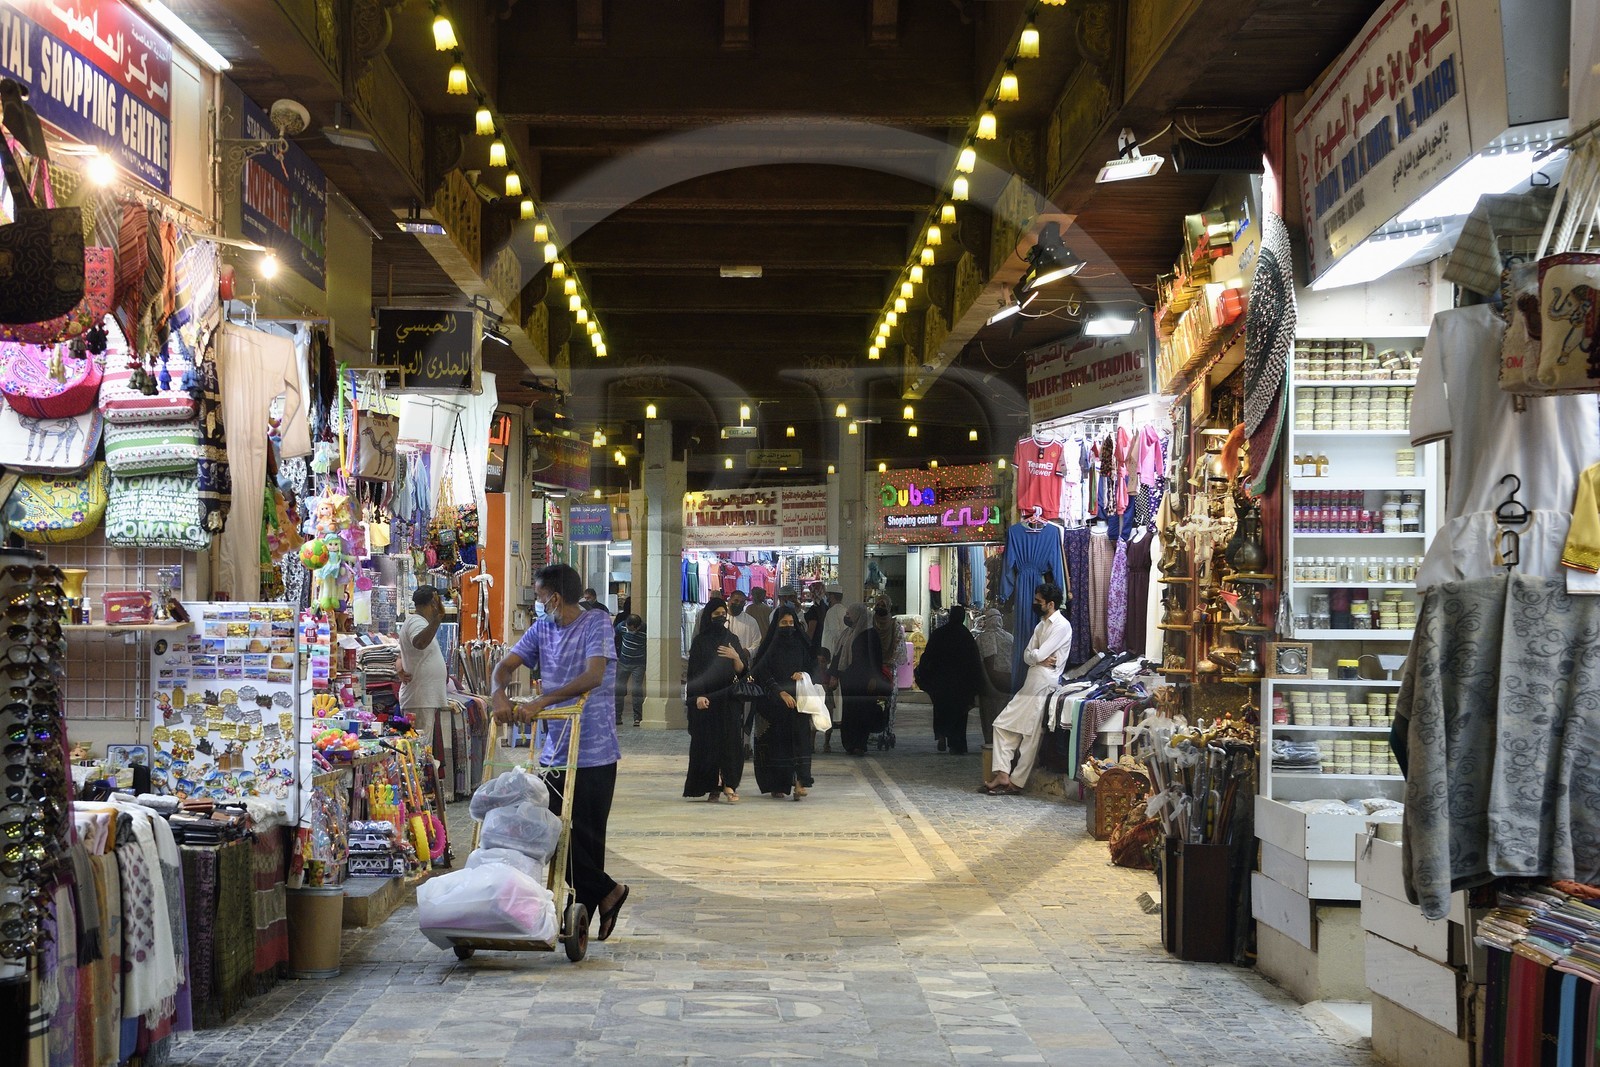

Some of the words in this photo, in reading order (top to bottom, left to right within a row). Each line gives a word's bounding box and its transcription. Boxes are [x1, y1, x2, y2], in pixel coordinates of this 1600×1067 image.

[46, 0, 124, 65] العاصم
[1405, 0, 1453, 84] عوض
[124, 45, 169, 103] مركز
[1387, 50, 1405, 101] بن
[41, 36, 117, 137] SHOPPING
[121, 93, 168, 171] CENTRE
[1353, 66, 1385, 139] عامر
[1396, 53, 1457, 144] AL-MAHRI
[396, 313, 457, 343] الحبسي
[426, 350, 470, 379] للحلوى
[1090, 349, 1145, 382] TRADING
[1027, 460, 1046, 468] Team
[1028, 467, 1052, 477] Viewer
[124, 521, 182, 539] OMAN
[588, 524, 603, 535] SHOP
[887, 515, 916, 527] Shopping
[917, 514, 938, 525] center
[941, 506, 1000, 534] دبي
